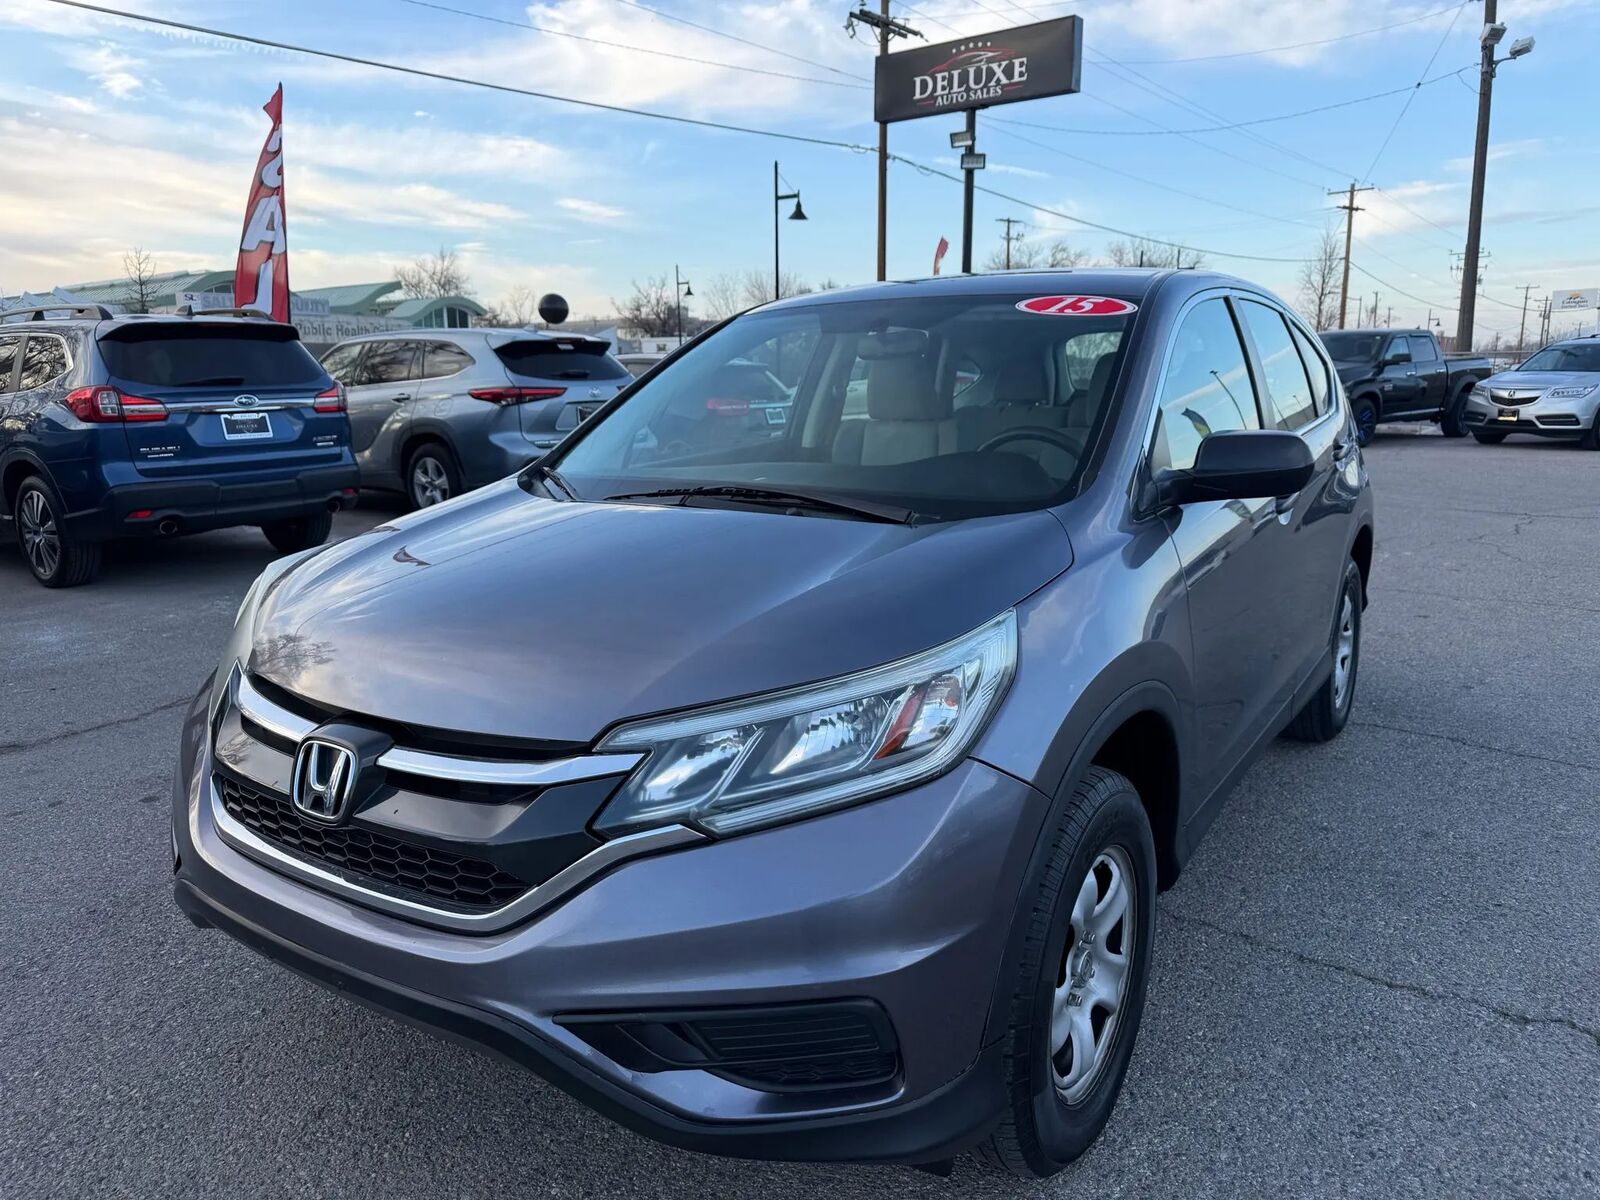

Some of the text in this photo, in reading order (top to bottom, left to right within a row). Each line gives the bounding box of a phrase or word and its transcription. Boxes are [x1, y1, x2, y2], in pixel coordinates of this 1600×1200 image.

[912, 57, 1028, 100] DELUXE
[936, 85, 1002, 106] AUTO SALES
[1040, 297, 1107, 313] 15
[295, 322, 332, 338] Public
[335, 323, 371, 338] Health
